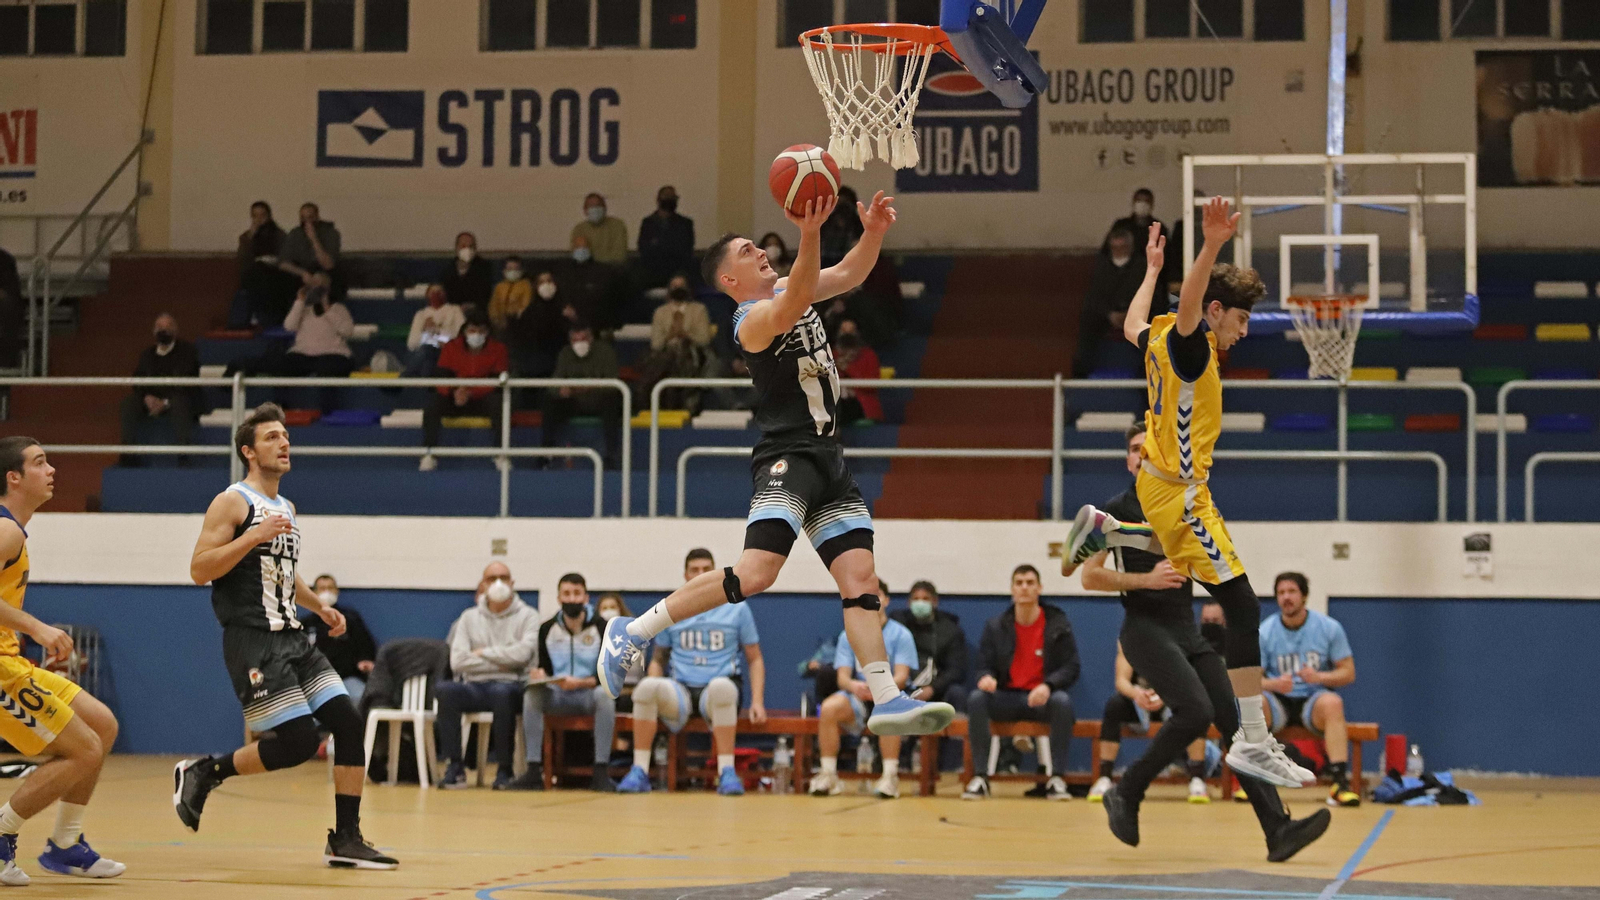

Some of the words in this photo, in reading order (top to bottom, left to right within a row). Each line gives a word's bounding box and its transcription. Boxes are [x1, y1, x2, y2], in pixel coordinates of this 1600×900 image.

[1048, 67, 1134, 104] UBAGO
[1145, 67, 1234, 103] GROUP
[437, 87, 620, 167] STROG
[1049, 112, 1231, 140] www.ubagogroup.com
[914, 125, 1021, 177] UBAGO
[680, 629, 725, 651] ULB
